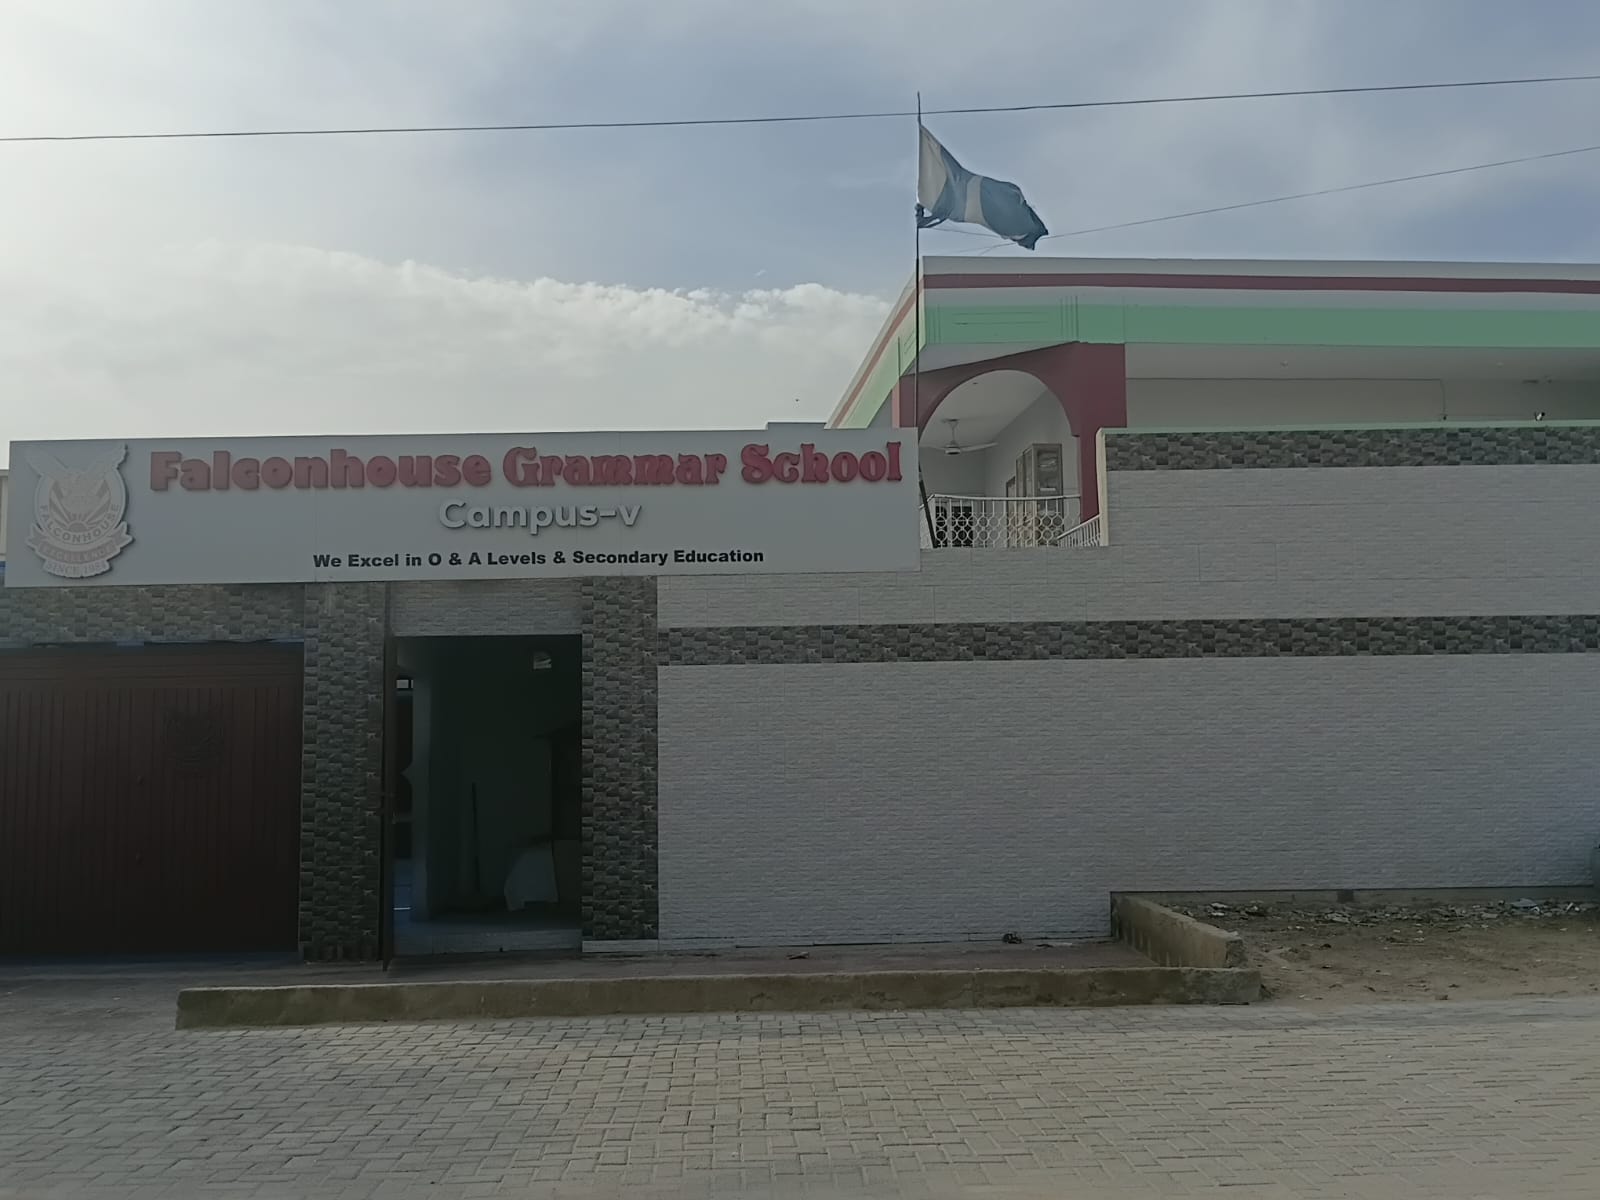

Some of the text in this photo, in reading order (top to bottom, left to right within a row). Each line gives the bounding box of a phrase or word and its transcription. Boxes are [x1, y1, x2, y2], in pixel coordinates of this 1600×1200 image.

[150, 441, 903, 491] Falconhouse Grammar School
[39, 503, 120, 544] FALCONHOUSE
[439, 499, 642, 536] Campus-v
[312, 549, 764, 568] We Excel in O & A Levels & Secondary Education
